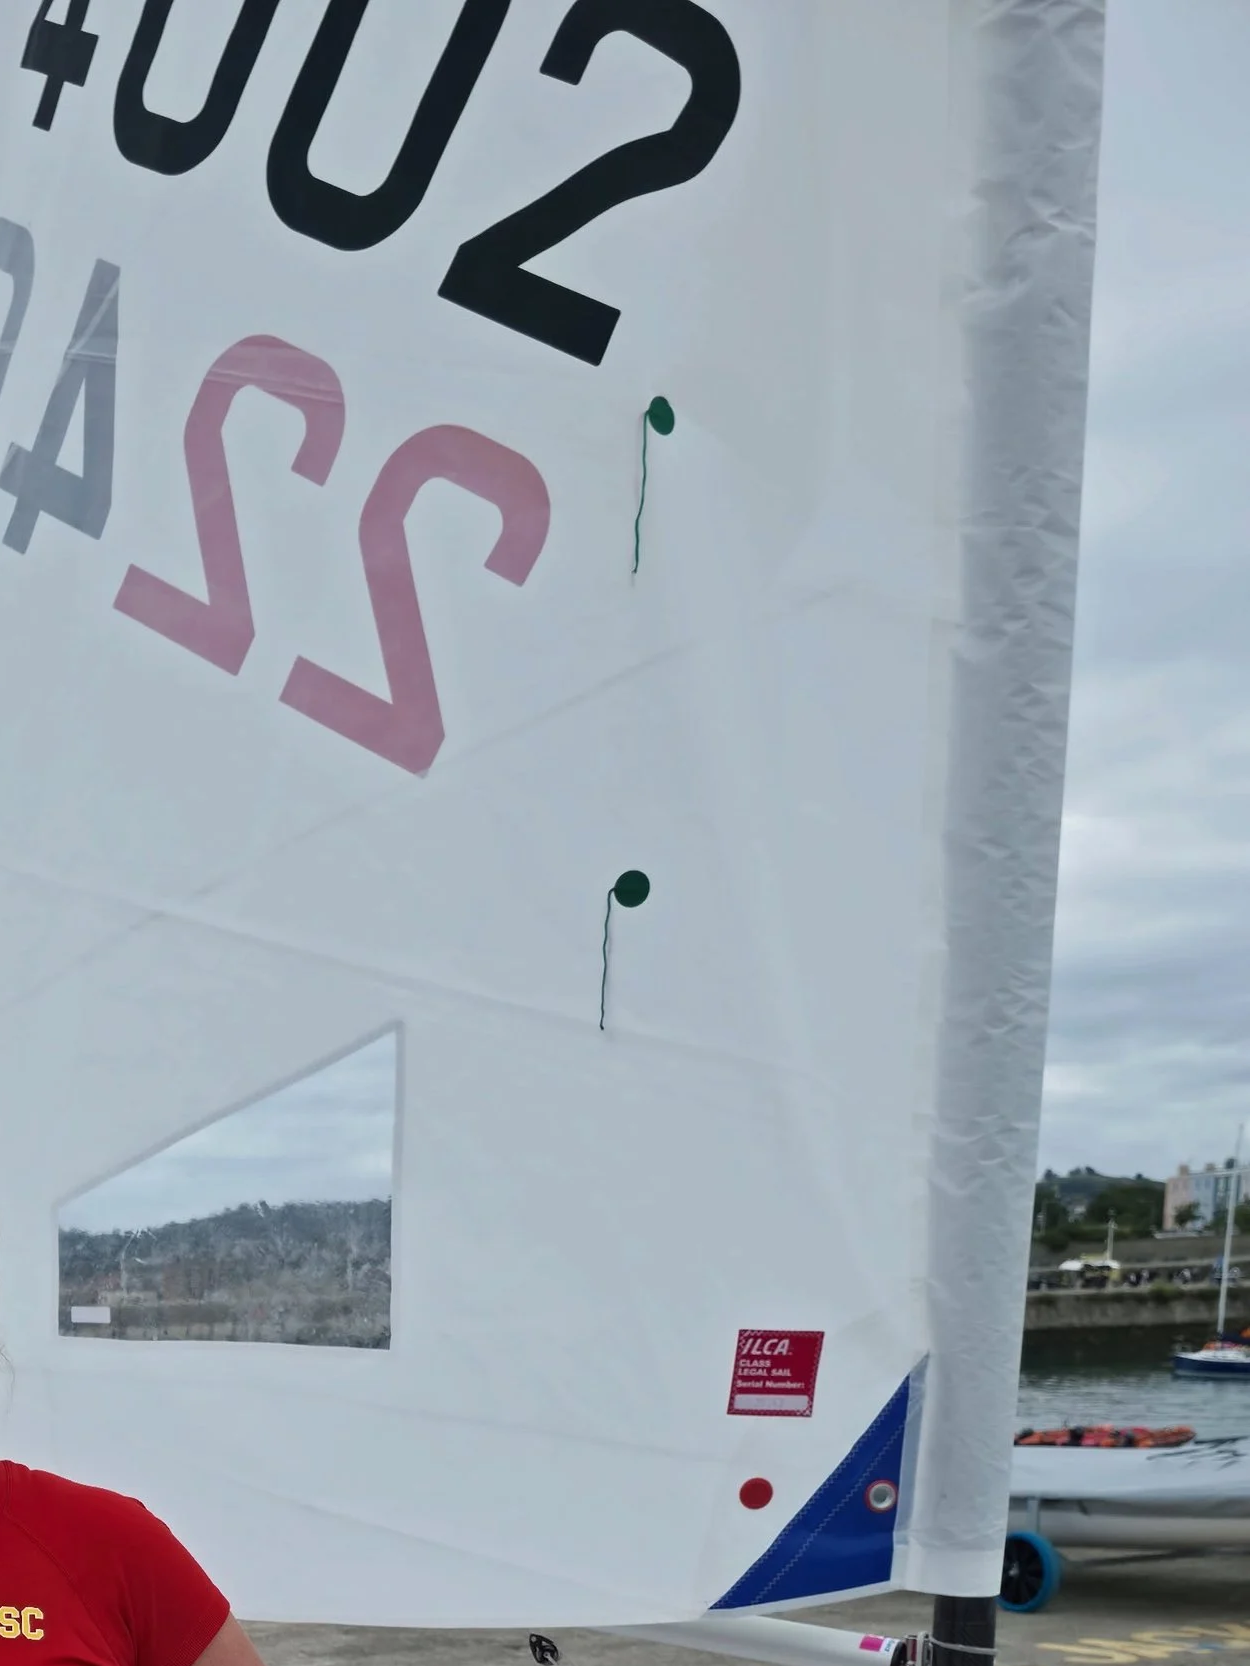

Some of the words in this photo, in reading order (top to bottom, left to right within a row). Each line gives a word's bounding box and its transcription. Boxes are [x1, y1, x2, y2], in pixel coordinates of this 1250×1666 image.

[742, 1338, 790, 1356] ILCA
[739, 1359, 771, 1368] CLASS
[737, 1368, 768, 1377] LEGAL
[771, 1369, 792, 1377] SAIL
[736, 1380, 763, 1388] Serial
[765, 1381, 805, 1389] Number:
